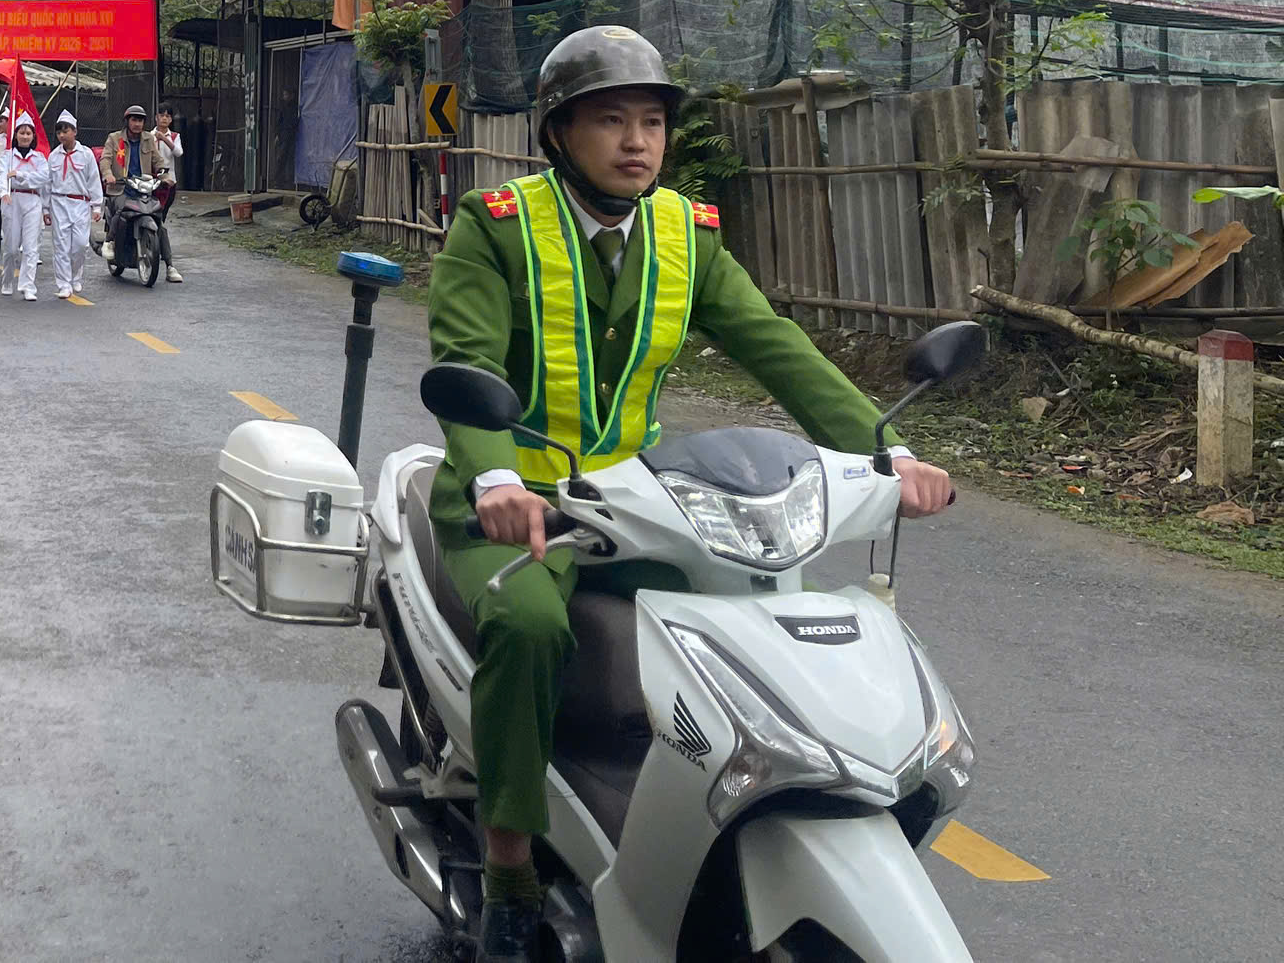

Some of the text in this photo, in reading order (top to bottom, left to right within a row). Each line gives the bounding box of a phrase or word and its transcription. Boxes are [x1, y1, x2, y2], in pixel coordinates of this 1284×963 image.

[31, 6, 55, 27] QUỐC
[797, 625, 857, 636] HONDA
[656, 729, 708, 773] HONDA
